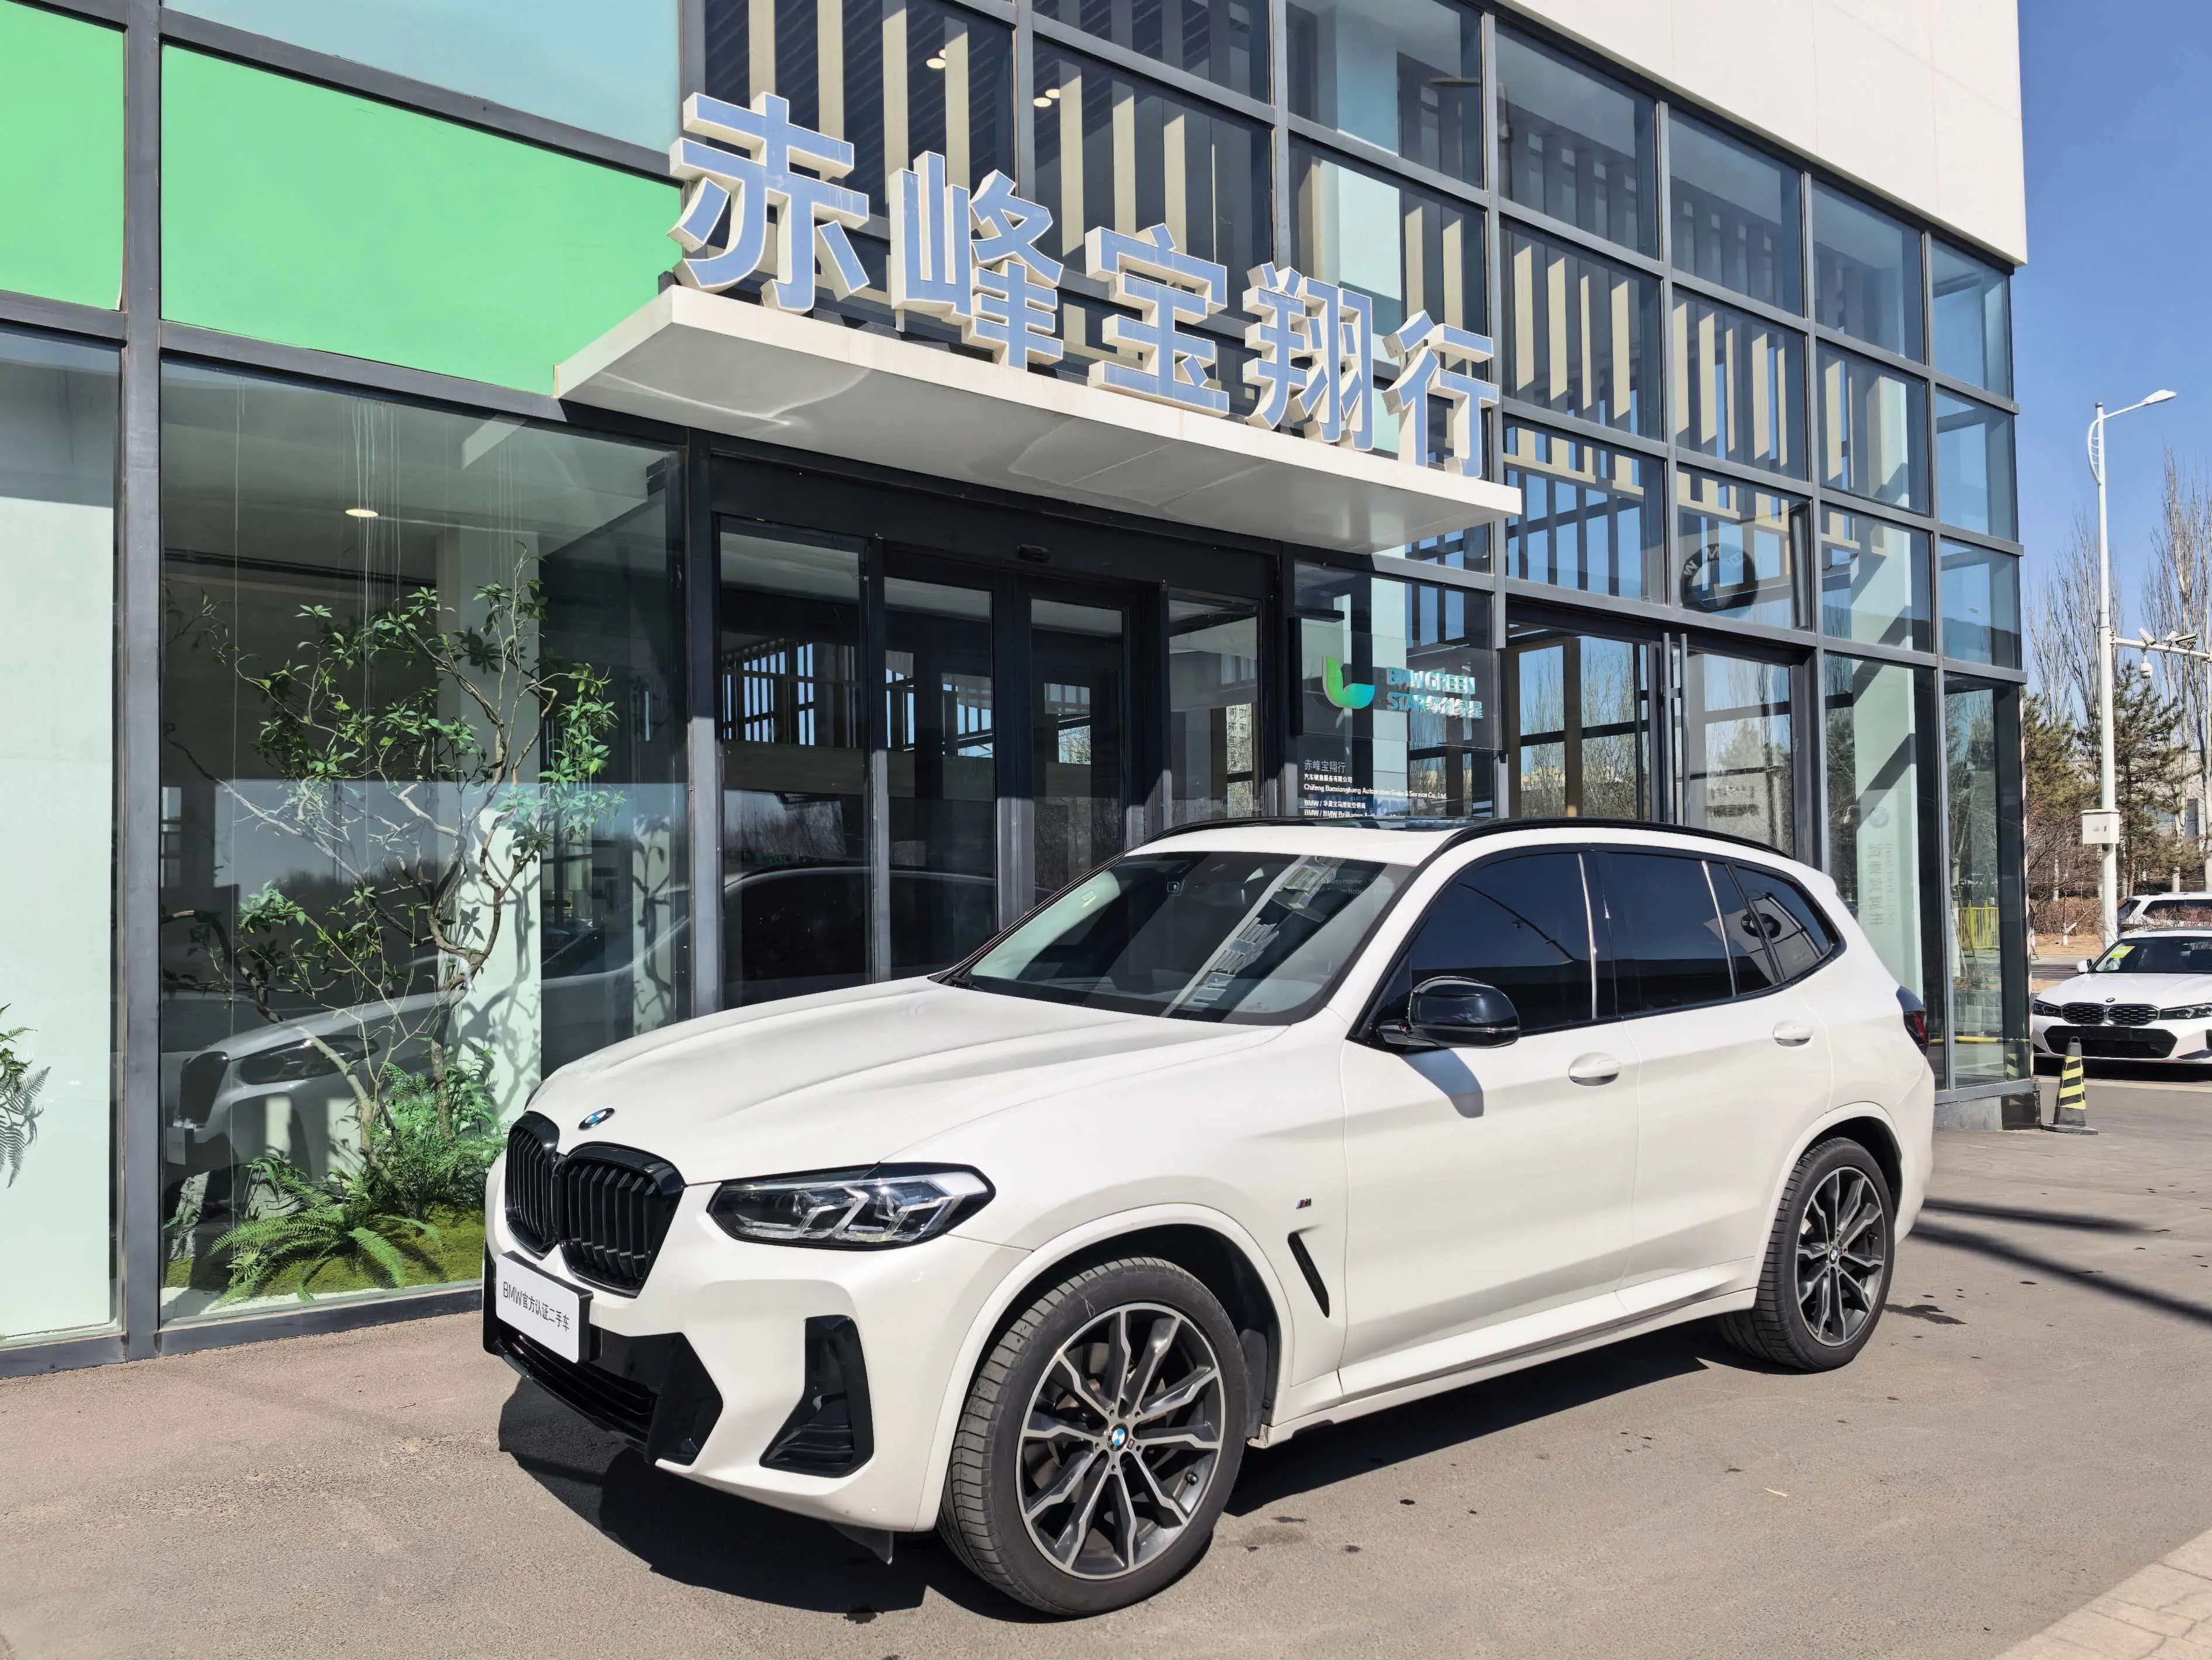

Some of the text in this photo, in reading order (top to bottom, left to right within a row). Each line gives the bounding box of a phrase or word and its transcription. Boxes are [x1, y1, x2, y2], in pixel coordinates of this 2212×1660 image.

[668, 92, 1499, 479] 赤峰宝翔行
[1425, 672, 1476, 694] GREEN
[1387, 692, 1425, 713] STAR
[1304, 759, 1346, 773] 赤峰宝翔行
[1304, 773, 1352, 783] 汽车销售服务有限公司
[1304, 783, 1324, 793] Chifeng
[1325, 785, 1361, 795] Baoxianghang
[1304, 809, 1319, 817] BMW
[1323, 810, 1337, 818] BMW
[503, 1281, 569, 1332] BMW官方认证二手车
